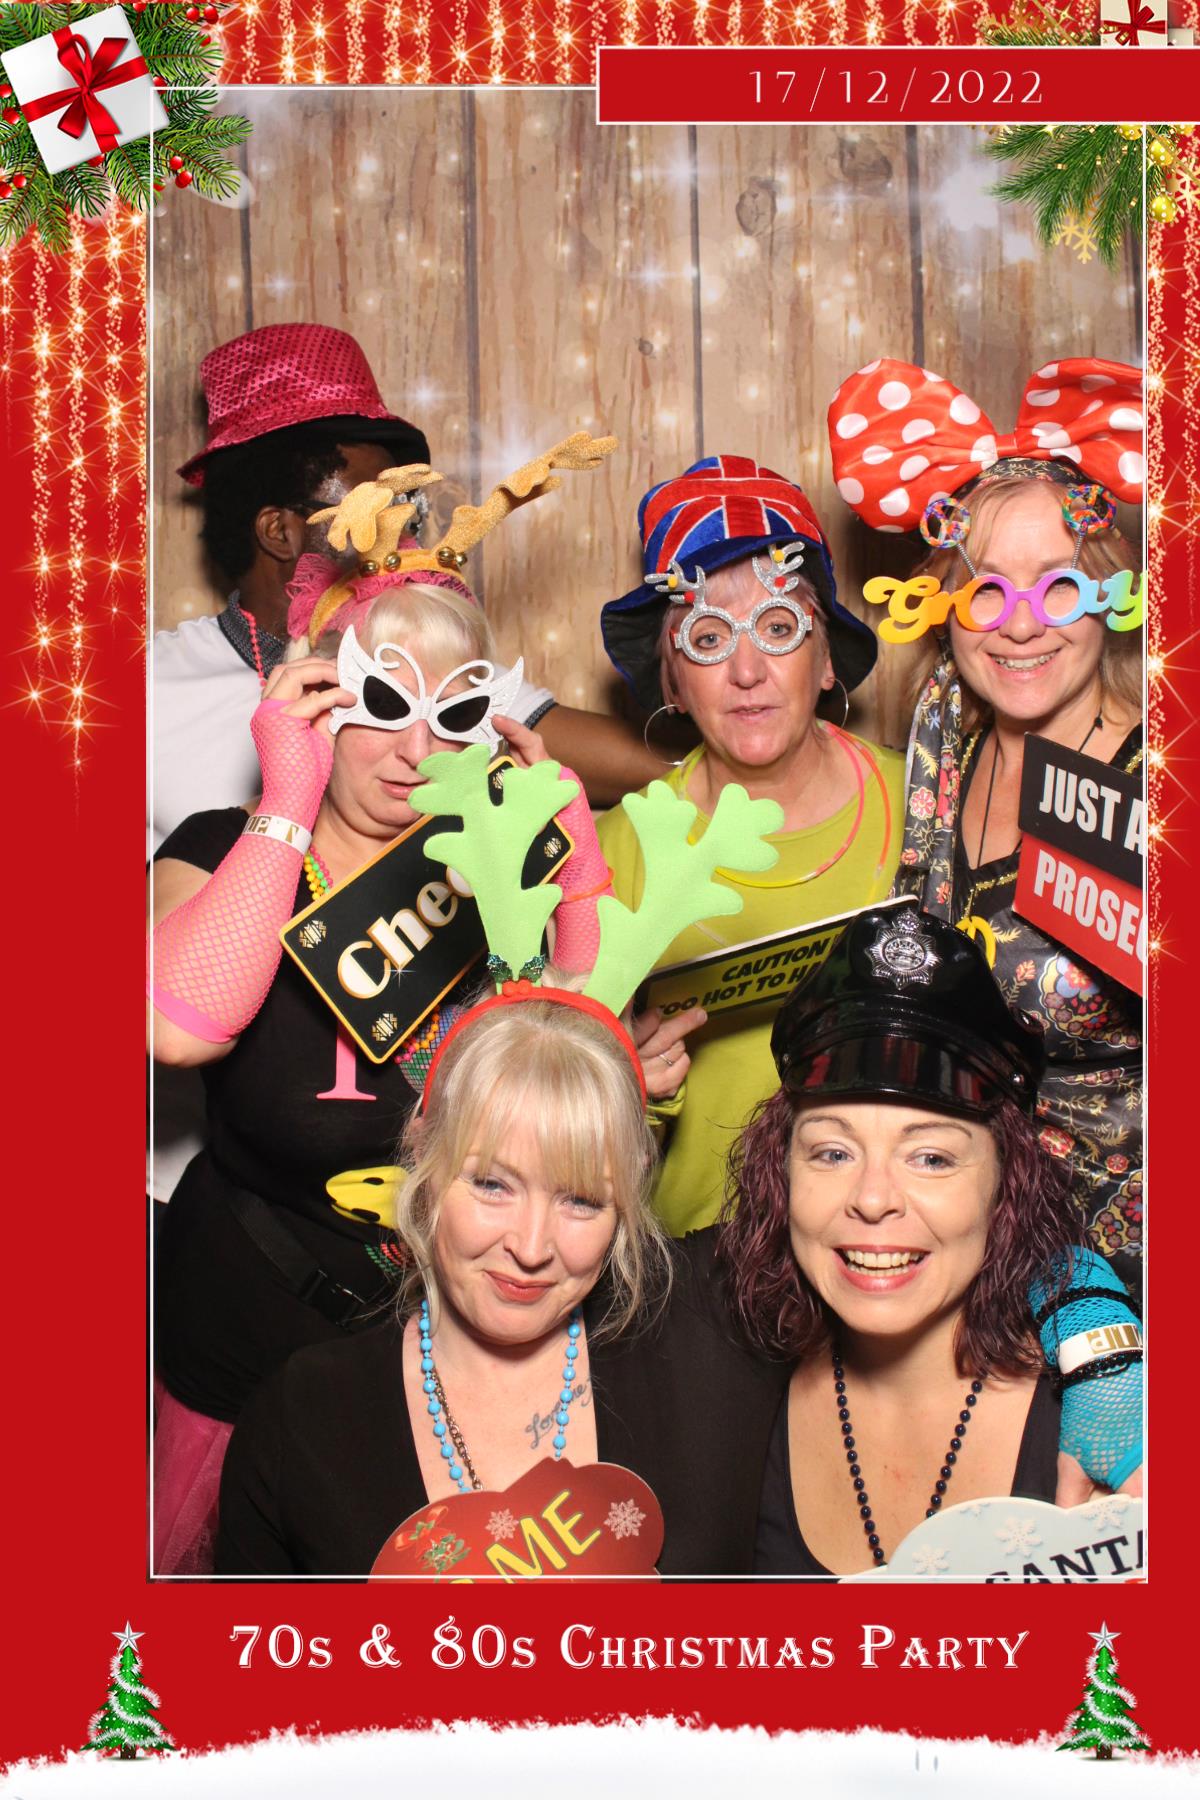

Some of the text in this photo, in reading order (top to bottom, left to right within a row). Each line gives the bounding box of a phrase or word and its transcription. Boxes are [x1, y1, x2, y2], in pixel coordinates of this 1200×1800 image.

[1039, 763, 1121, 842] JUST
[659, 996, 698, 1016] OO
[702, 981, 752, 1006] HOT
[756, 972, 786, 992] TO
[485, 1489, 601, 1584] ME
